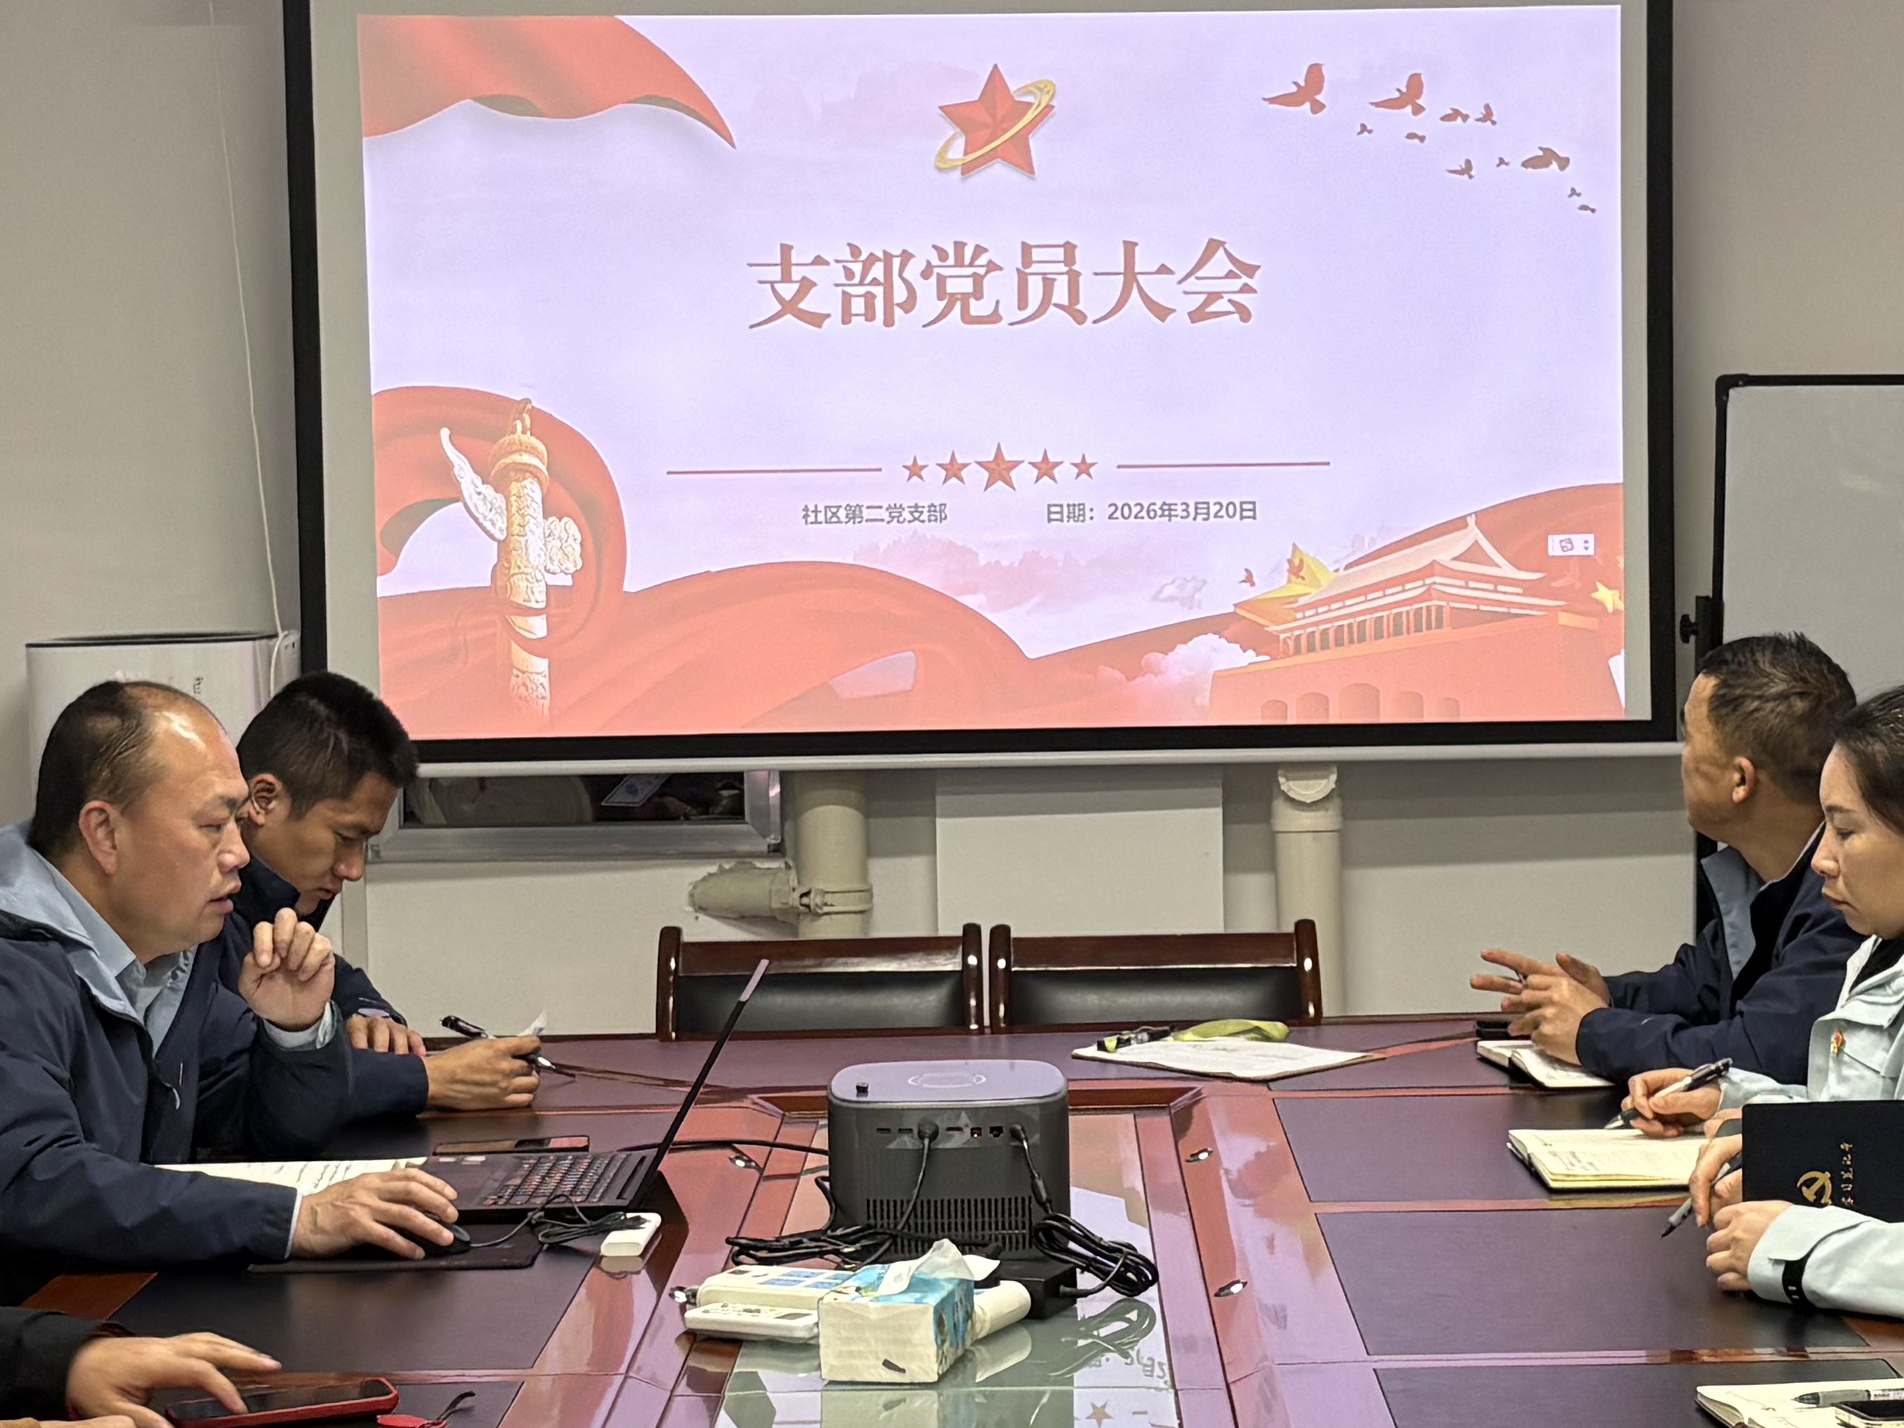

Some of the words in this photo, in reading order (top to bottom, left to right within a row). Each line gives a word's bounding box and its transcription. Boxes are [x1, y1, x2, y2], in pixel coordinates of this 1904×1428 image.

[746, 237, 1262, 329] 支部党员大会
[801, 502, 948, 525] 社区第二党支部
